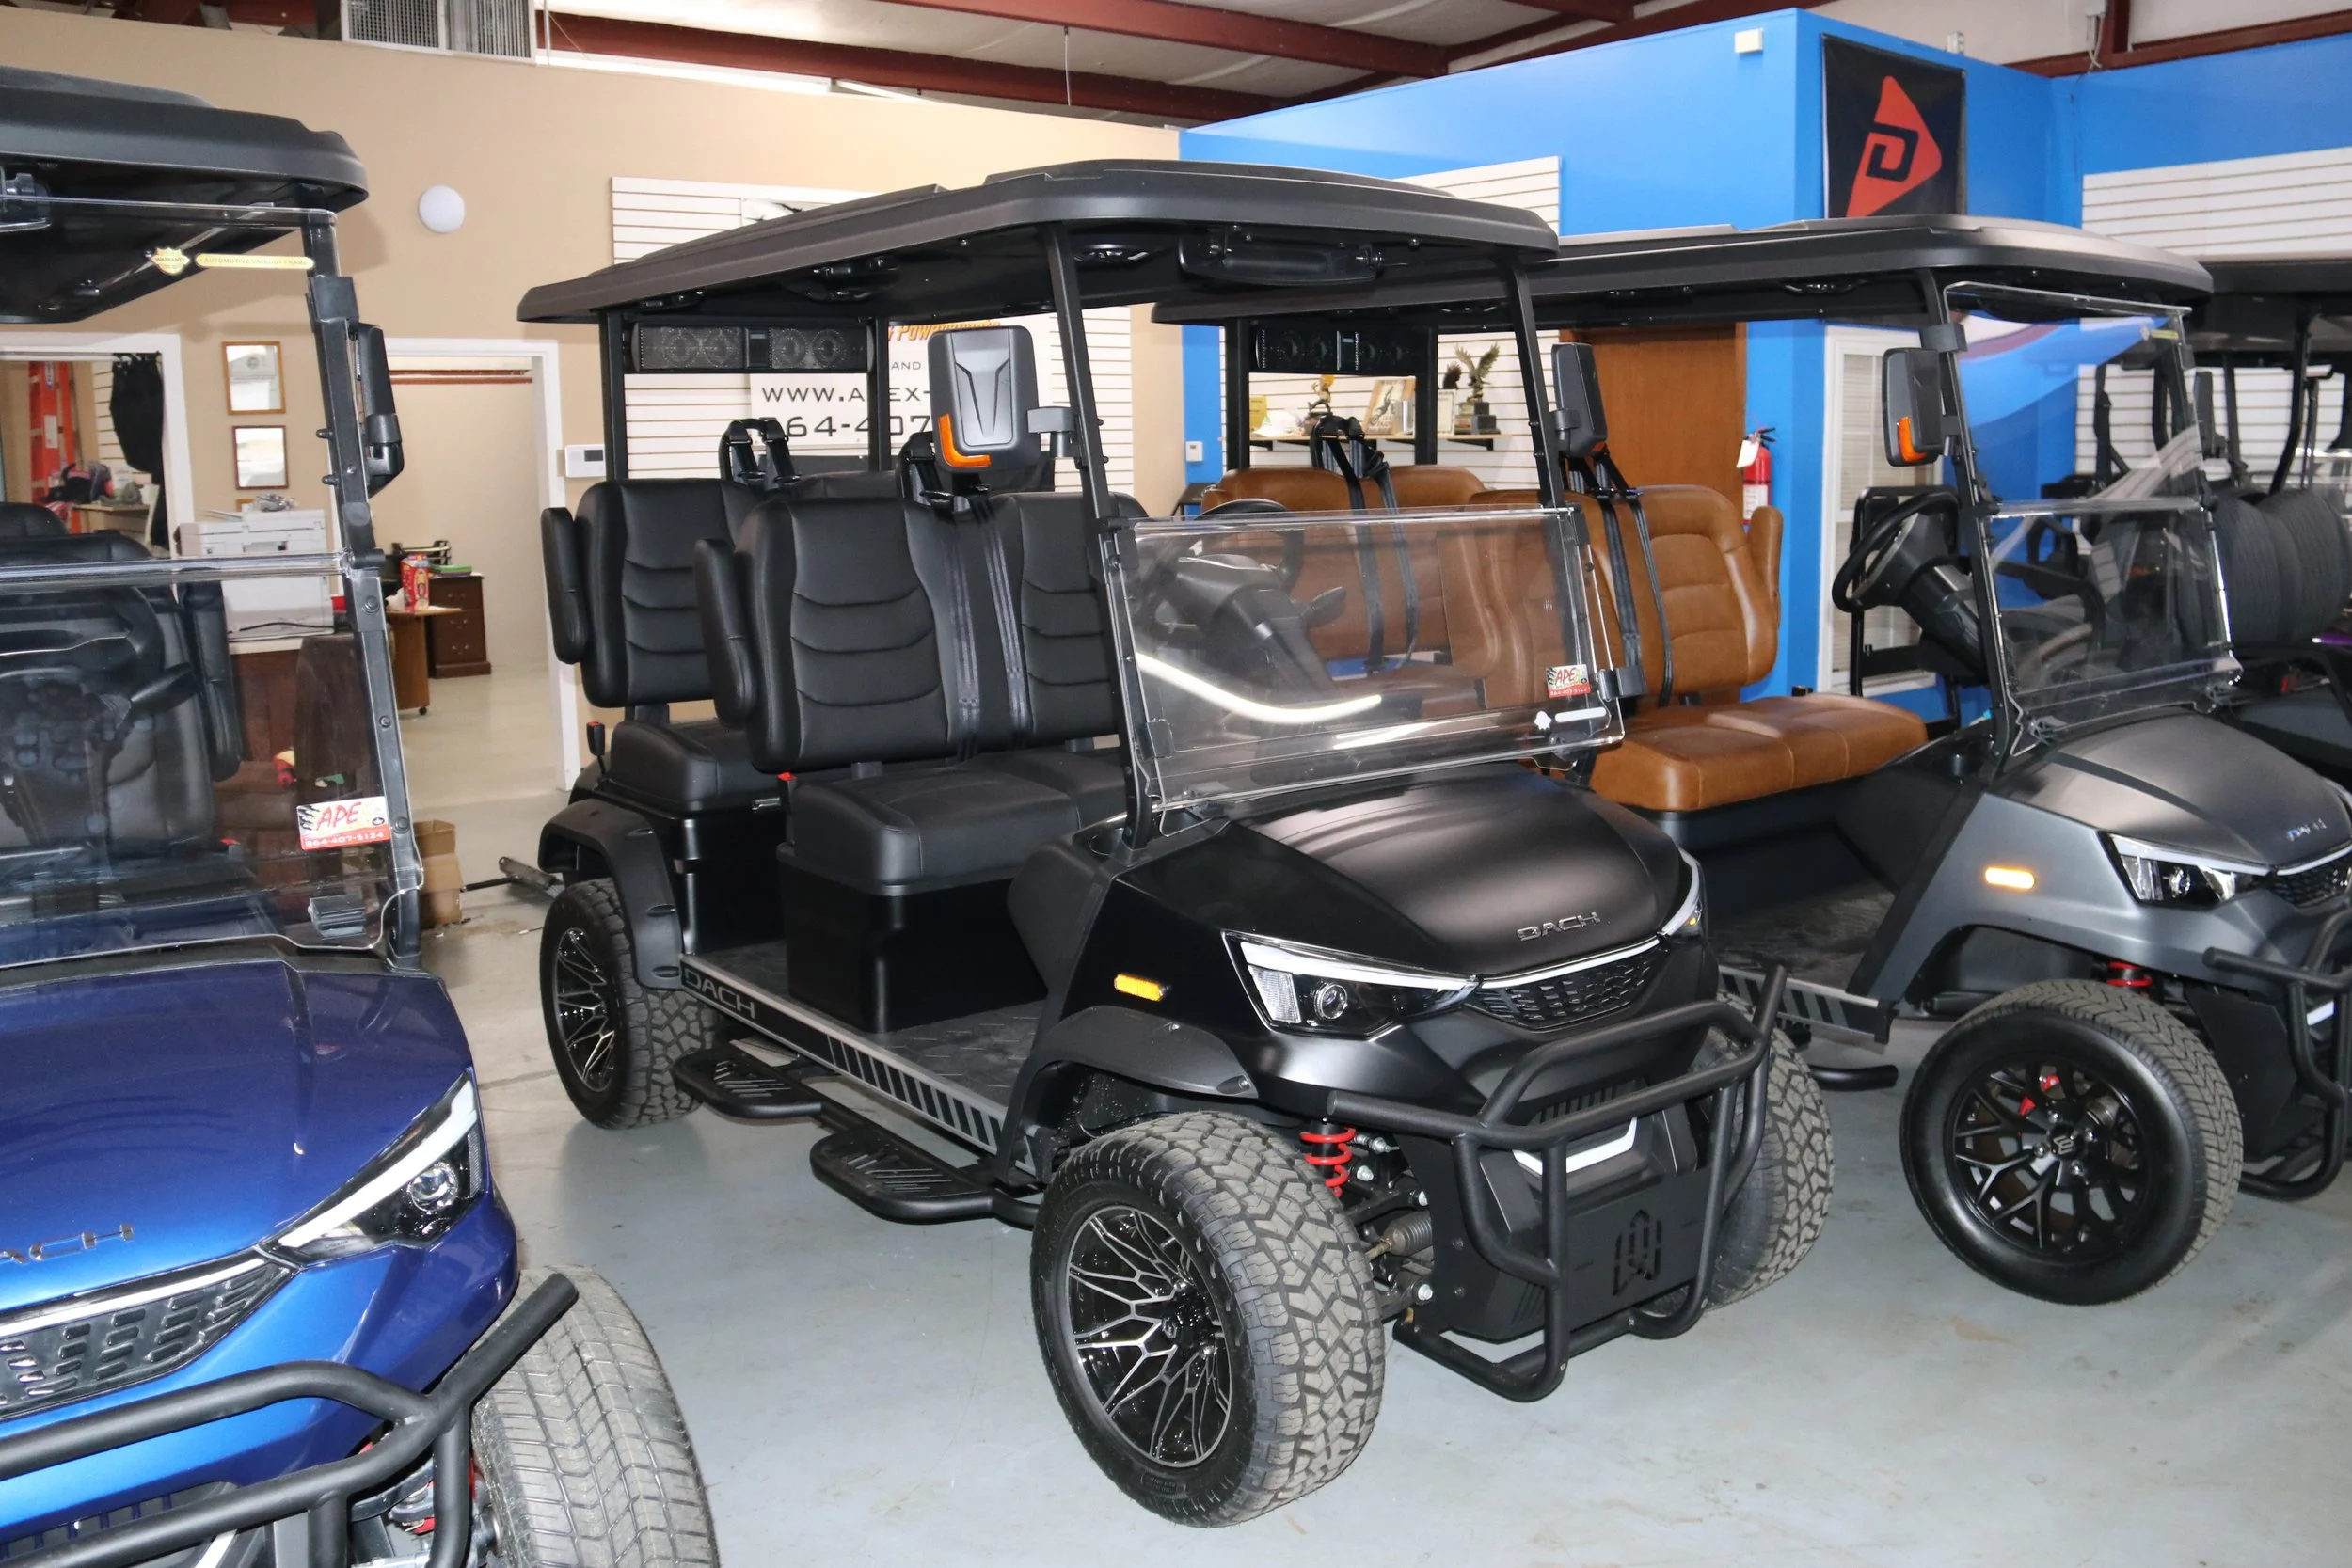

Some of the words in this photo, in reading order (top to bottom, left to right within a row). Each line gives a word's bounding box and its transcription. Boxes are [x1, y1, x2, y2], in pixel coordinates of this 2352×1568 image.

[891, 361, 921, 370] AND
[758, 416, 930, 437] 64-407
[1517, 911, 1600, 942] DACH
[684, 967, 755, 1019] DACH
